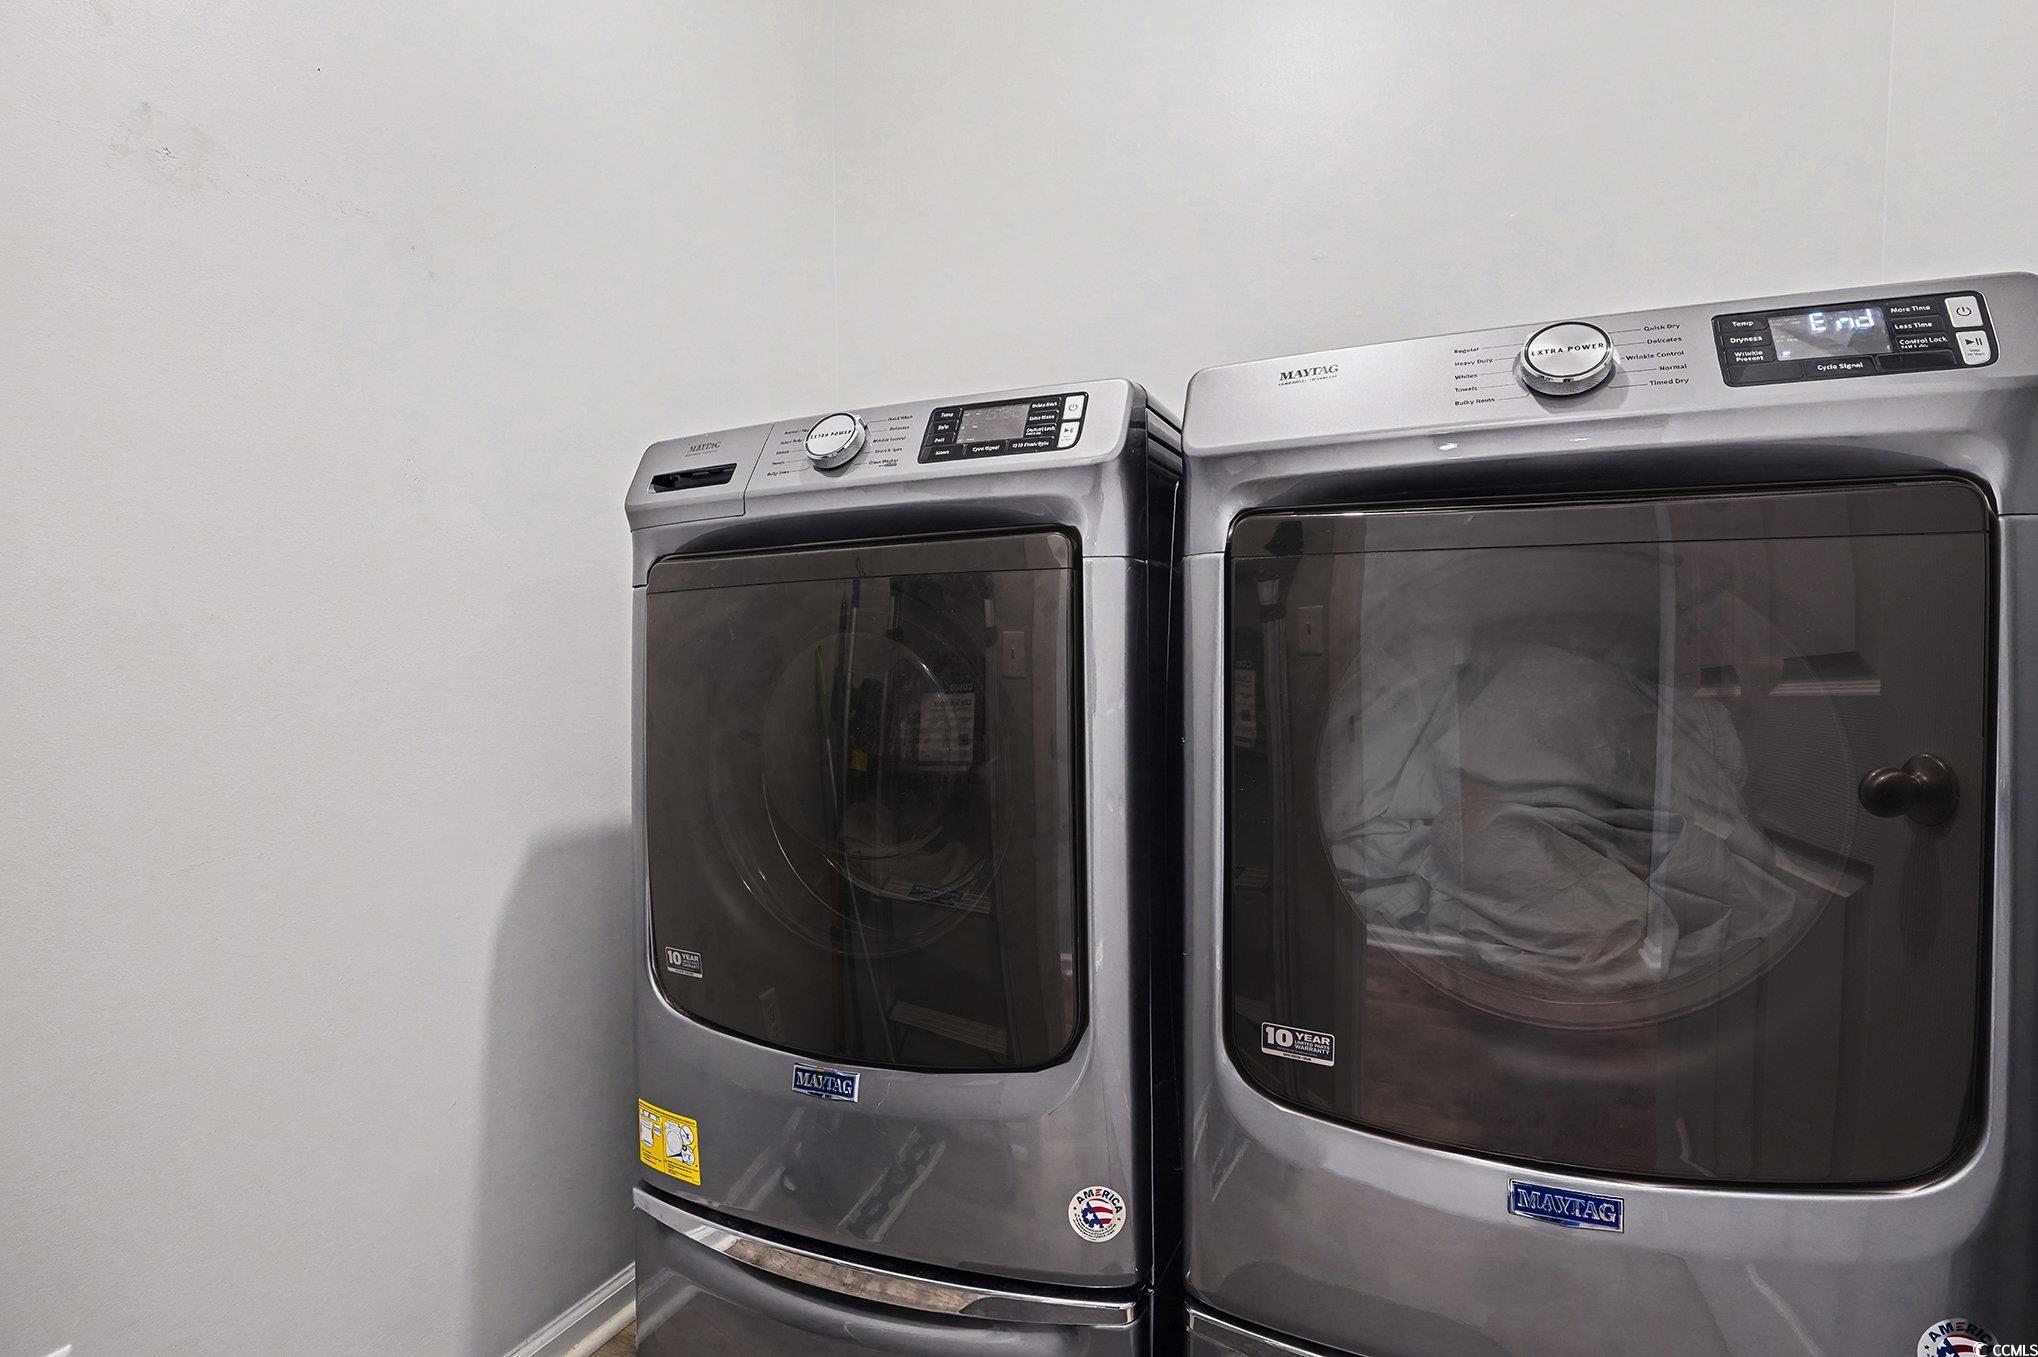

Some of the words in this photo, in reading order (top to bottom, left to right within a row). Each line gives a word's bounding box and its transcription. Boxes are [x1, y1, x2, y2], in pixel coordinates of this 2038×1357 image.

[1890, 306, 1911, 314] More
[1643, 324, 1666, 332] Quick
[1666, 323, 1681, 331] Dry
[1731, 320, 1754, 329] Temp
[1894, 322, 1913, 330] Less
[1646, 336, 1682, 344] Delicates
[1730, 335, 1763, 345] Dryness
[1899, 337, 1928, 346] Control
[1531, 347, 1564, 357] EXTRA
[1567, 342, 1604, 352] POWER
[1625, 352, 1655, 361] Wrinkle
[1656, 350, 1685, 358] Control
[1454, 359, 1477, 367] Heavy
[1477, 357, 1493, 365] Duty
[1838, 361, 1864, 371] Signal
[1278, 364, 1339, 382] MAYTAG
[1649, 378, 1672, 386] Timed
[1674, 377, 1690, 386] Dry
[1454, 385, 1478, 393] Towels
[667, 950, 682, 966] 10
[681, 953, 699, 962] YEAR
[1265, 1026, 1293, 1047] 10
[1295, 1032, 1330, 1046] YEAR
[1294, 1044, 1330, 1055] WARRANTY
[796, 1070, 853, 1095] MAYTAG
[1076, 1188, 1123, 1214] AMERICA
[1517, 1188, 1616, 1223] MAYTAG
